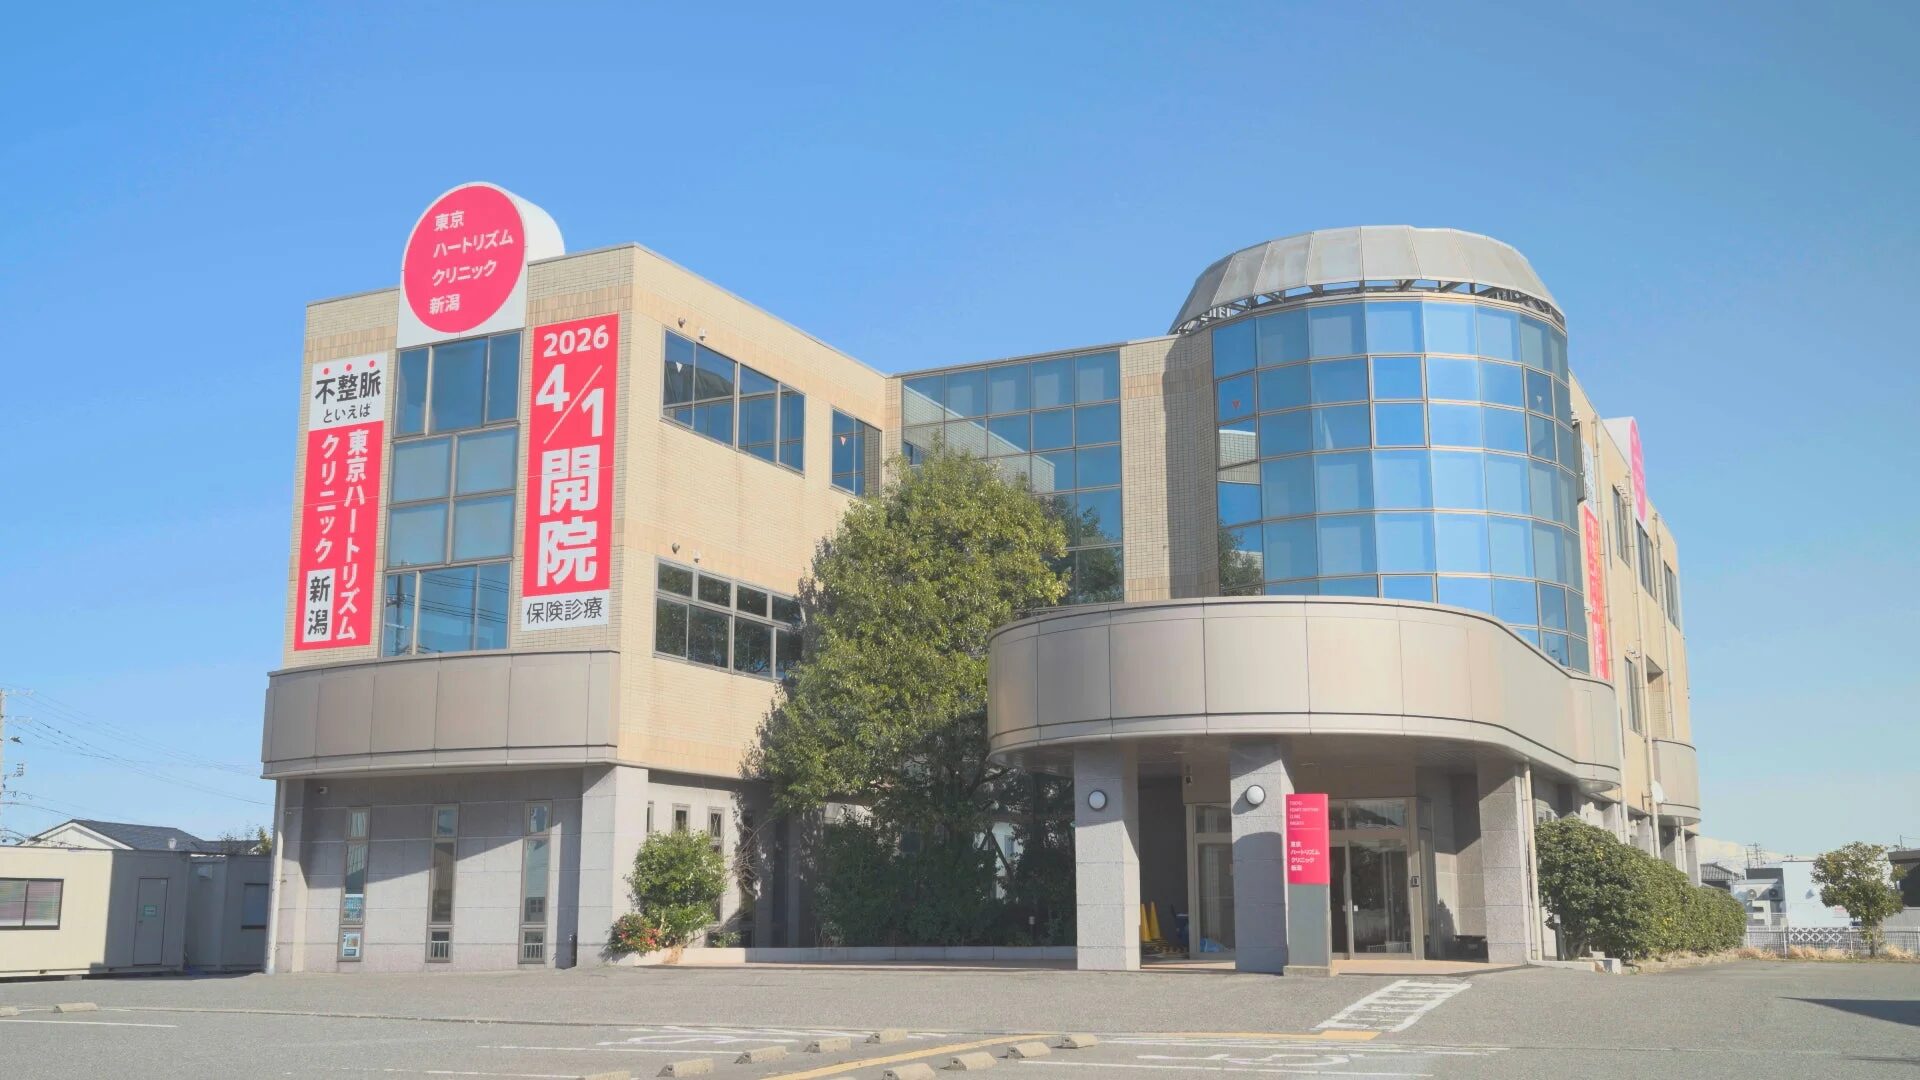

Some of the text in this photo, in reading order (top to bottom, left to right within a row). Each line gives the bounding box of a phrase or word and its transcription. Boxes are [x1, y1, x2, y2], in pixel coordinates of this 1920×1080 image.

[435, 210, 465, 232] 東京
[433, 229, 514, 258] ハートリズム
[432, 260, 497, 286] クリニック
[429, 294, 460, 315] 新潟
[543, 325, 609, 357] 2026
[315, 369, 382, 405] 不整脈
[323, 403, 371, 424] といえば
[536, 364, 604, 444] 4/1
[537, 445, 601, 587] 開院
[307, 434, 340, 637] クリニック 新潟
[336, 429, 369, 641] 東京ハートリズム
[526, 597, 603, 624] 保険診療
